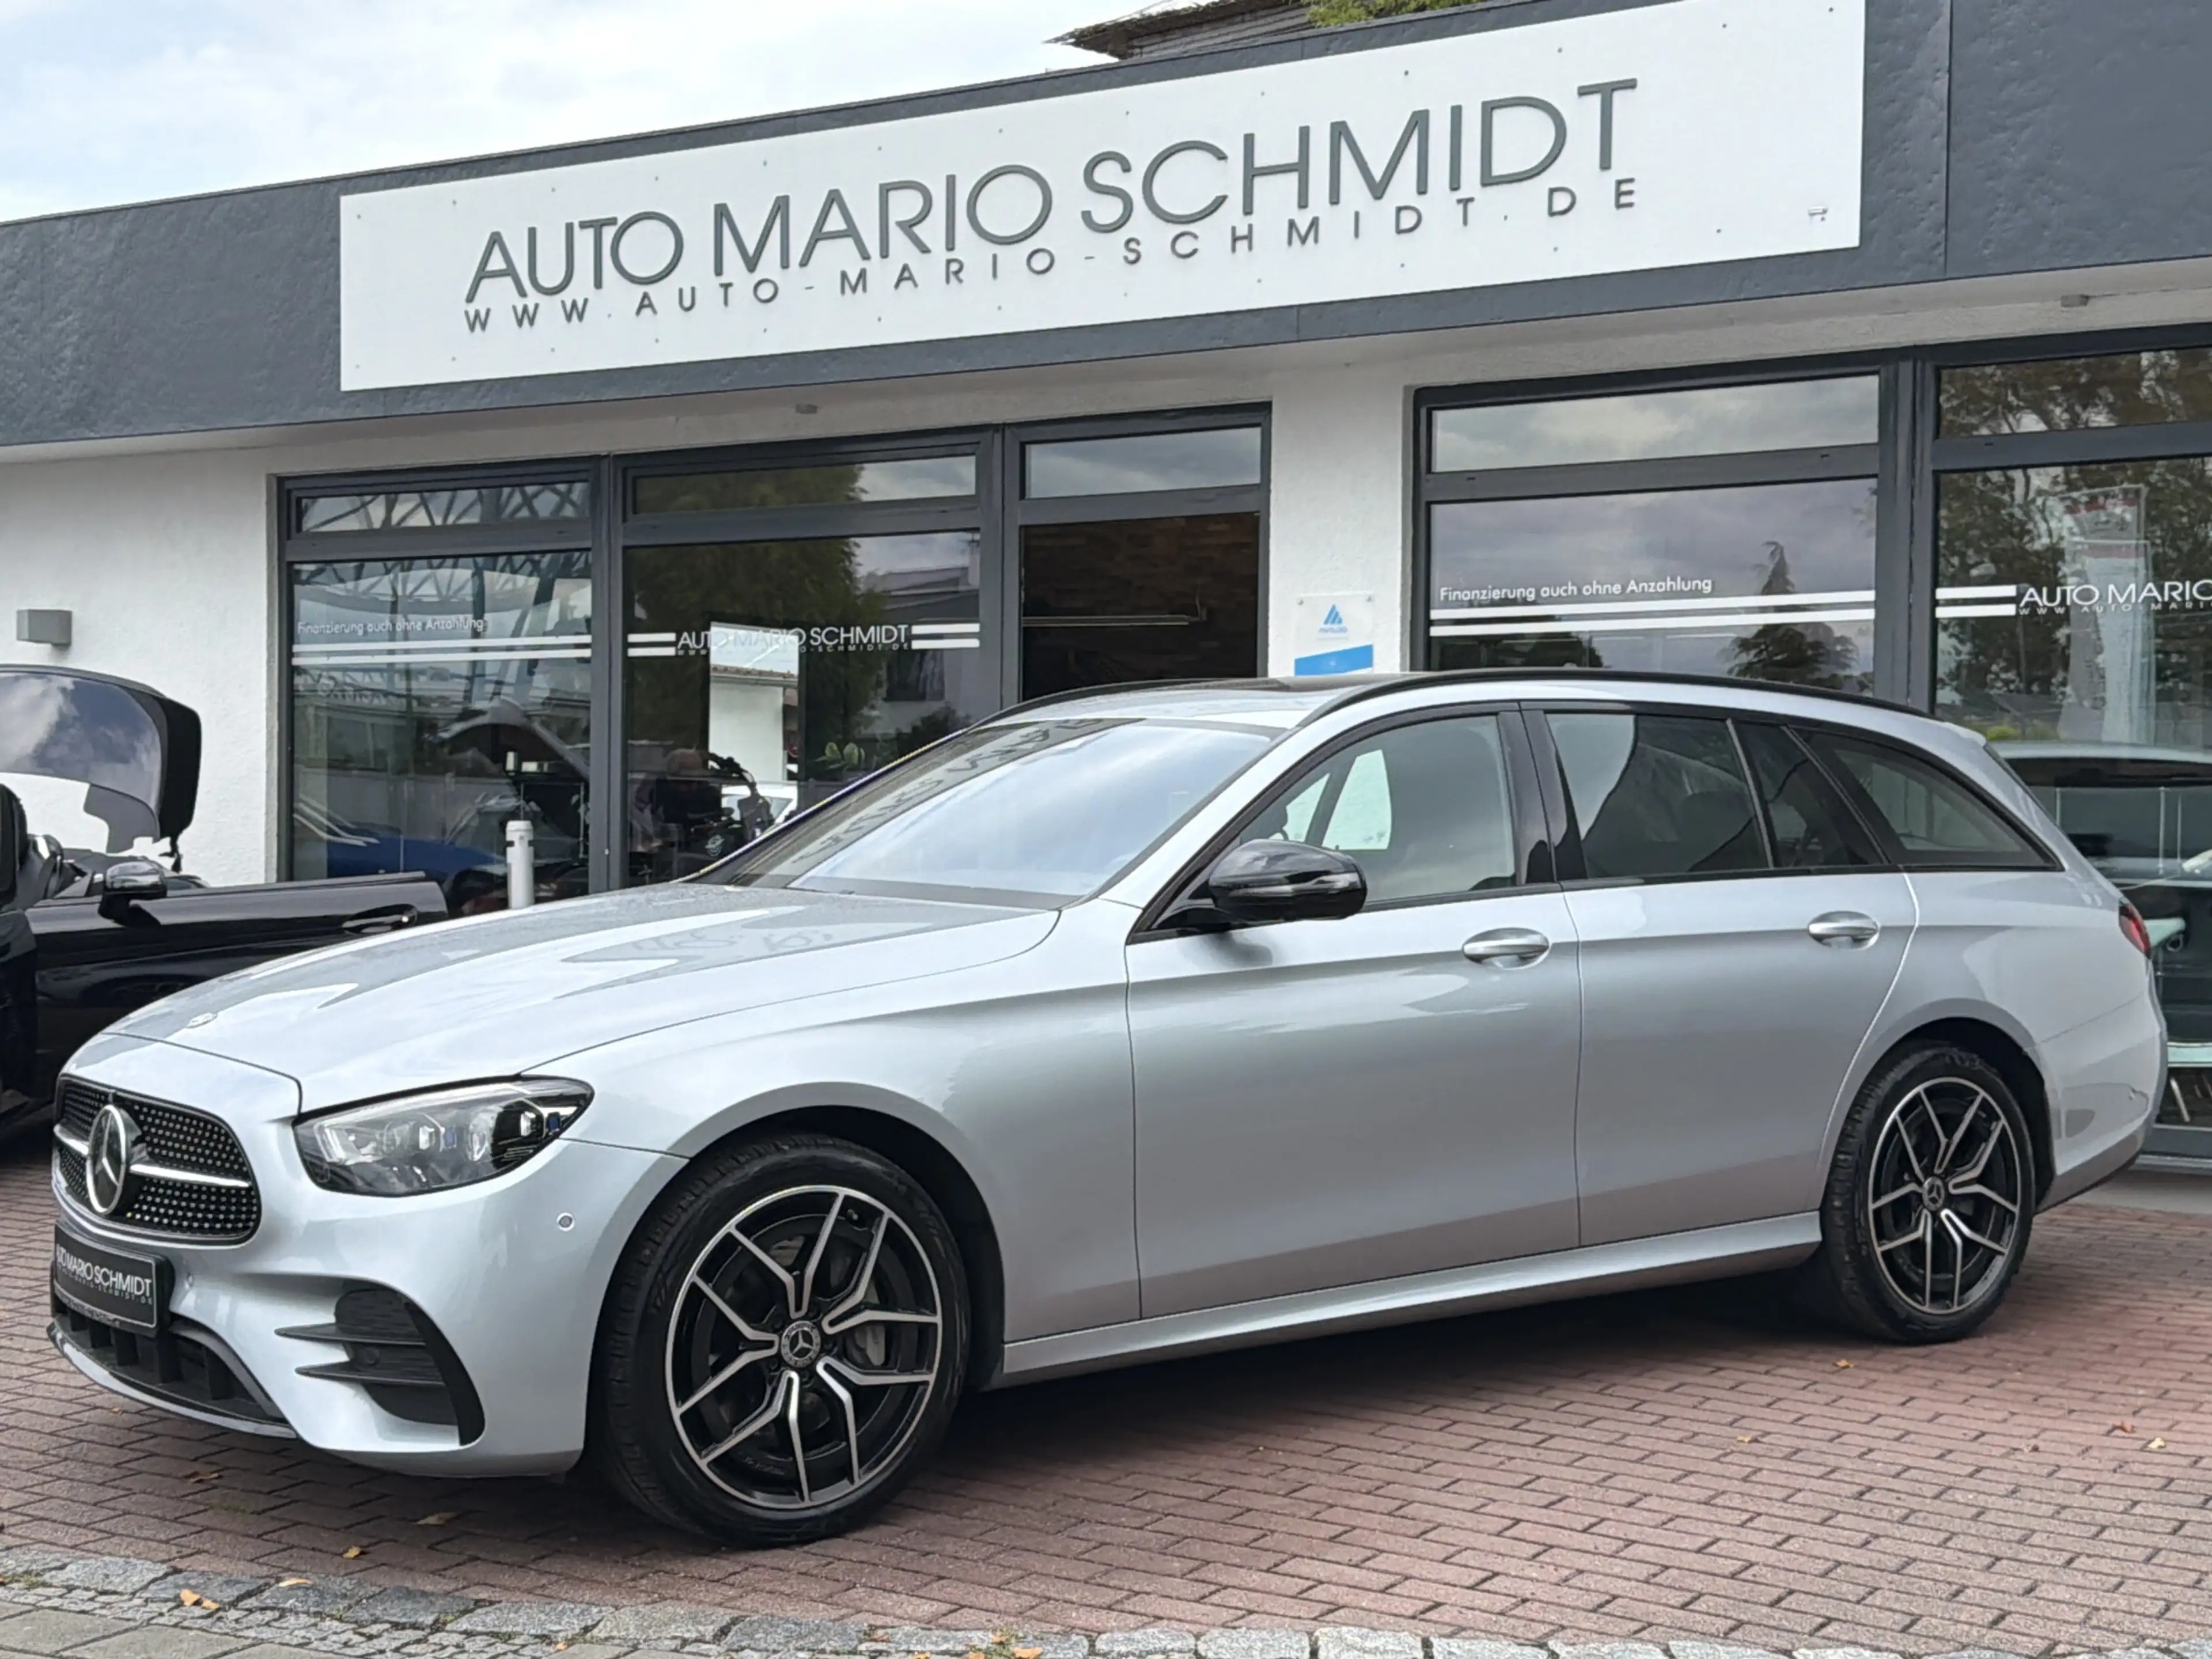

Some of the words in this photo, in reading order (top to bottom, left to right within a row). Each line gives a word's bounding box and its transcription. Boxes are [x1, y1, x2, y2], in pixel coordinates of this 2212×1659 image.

[465, 211, 684, 304] AUTO
[713, 164, 1052, 276] MARIO
[1081, 78, 1638, 233] SCHMIDT
[1440, 585, 1535, 601] Finanzierung
[1540, 582, 1577, 597] auch
[1582, 580, 1622, 595] ohne
[1627, 577, 1711, 594] Anzahlung
[2019, 584, 2100, 607] AUTO
[2108, 579, 2212, 604] MARIO
[298, 622, 363, 636] Finanzierung
[367, 621, 392, 632] auch
[395, 620, 422, 632] ohne
[426, 616, 484, 633] Anzahlung
[677, 631, 730, 649] AUTO
[810, 624, 908, 646] SCHMIDT
[94, 1265, 152, 1297] SCHMIDT
